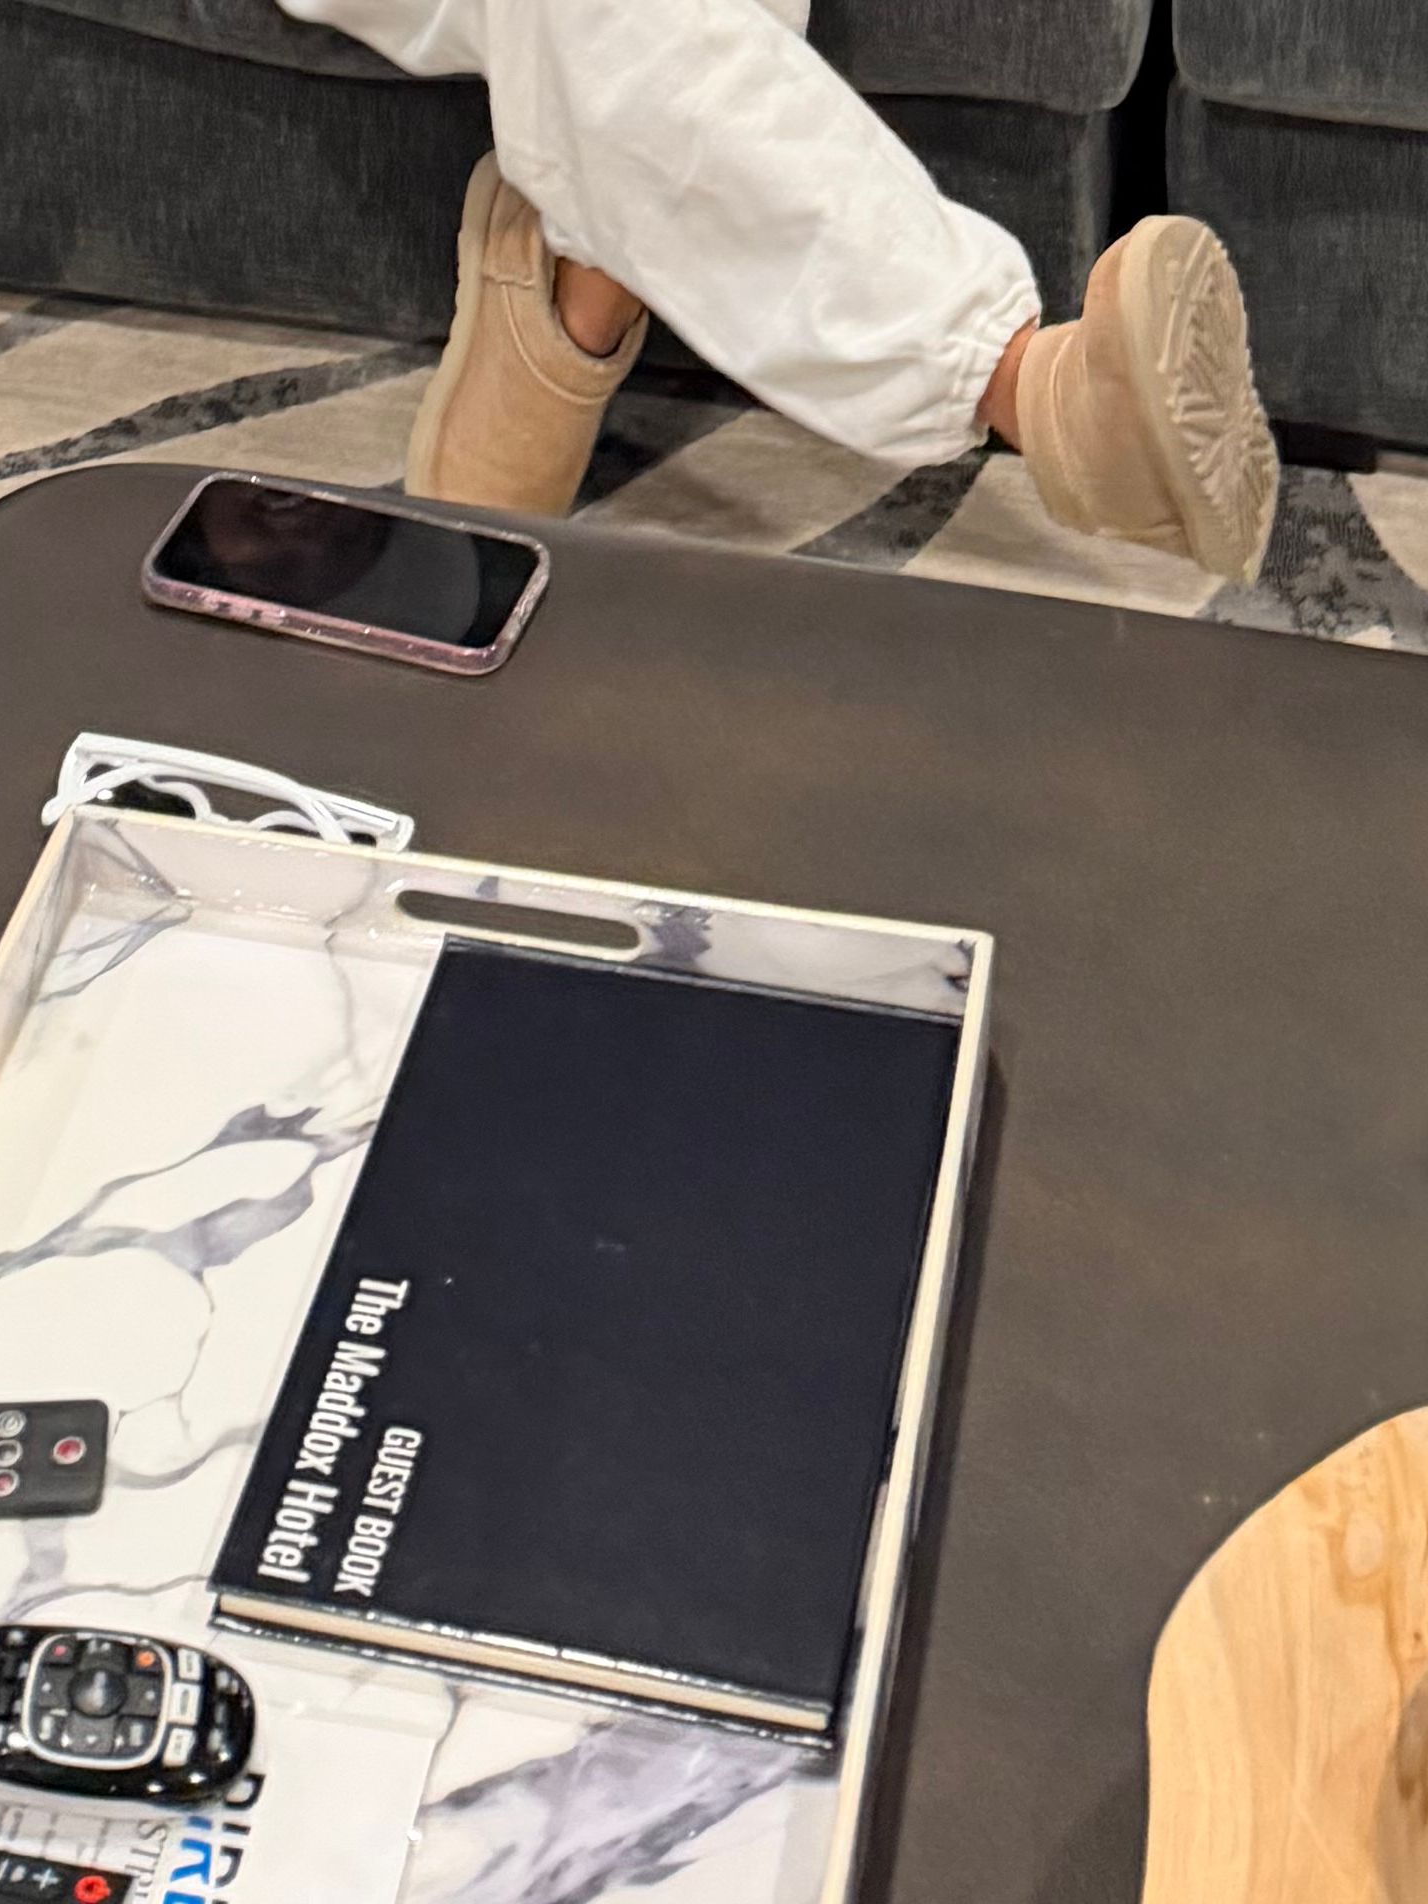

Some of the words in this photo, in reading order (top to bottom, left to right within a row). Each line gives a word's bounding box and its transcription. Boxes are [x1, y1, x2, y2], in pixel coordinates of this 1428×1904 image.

[344, 1277, 410, 1335] The
[294, 1340, 386, 1476] Maddox
[360, 1425, 423, 1515] GUEST
[257, 1478, 340, 1583] Hotel
[333, 1514, 395, 1597] BOOK
